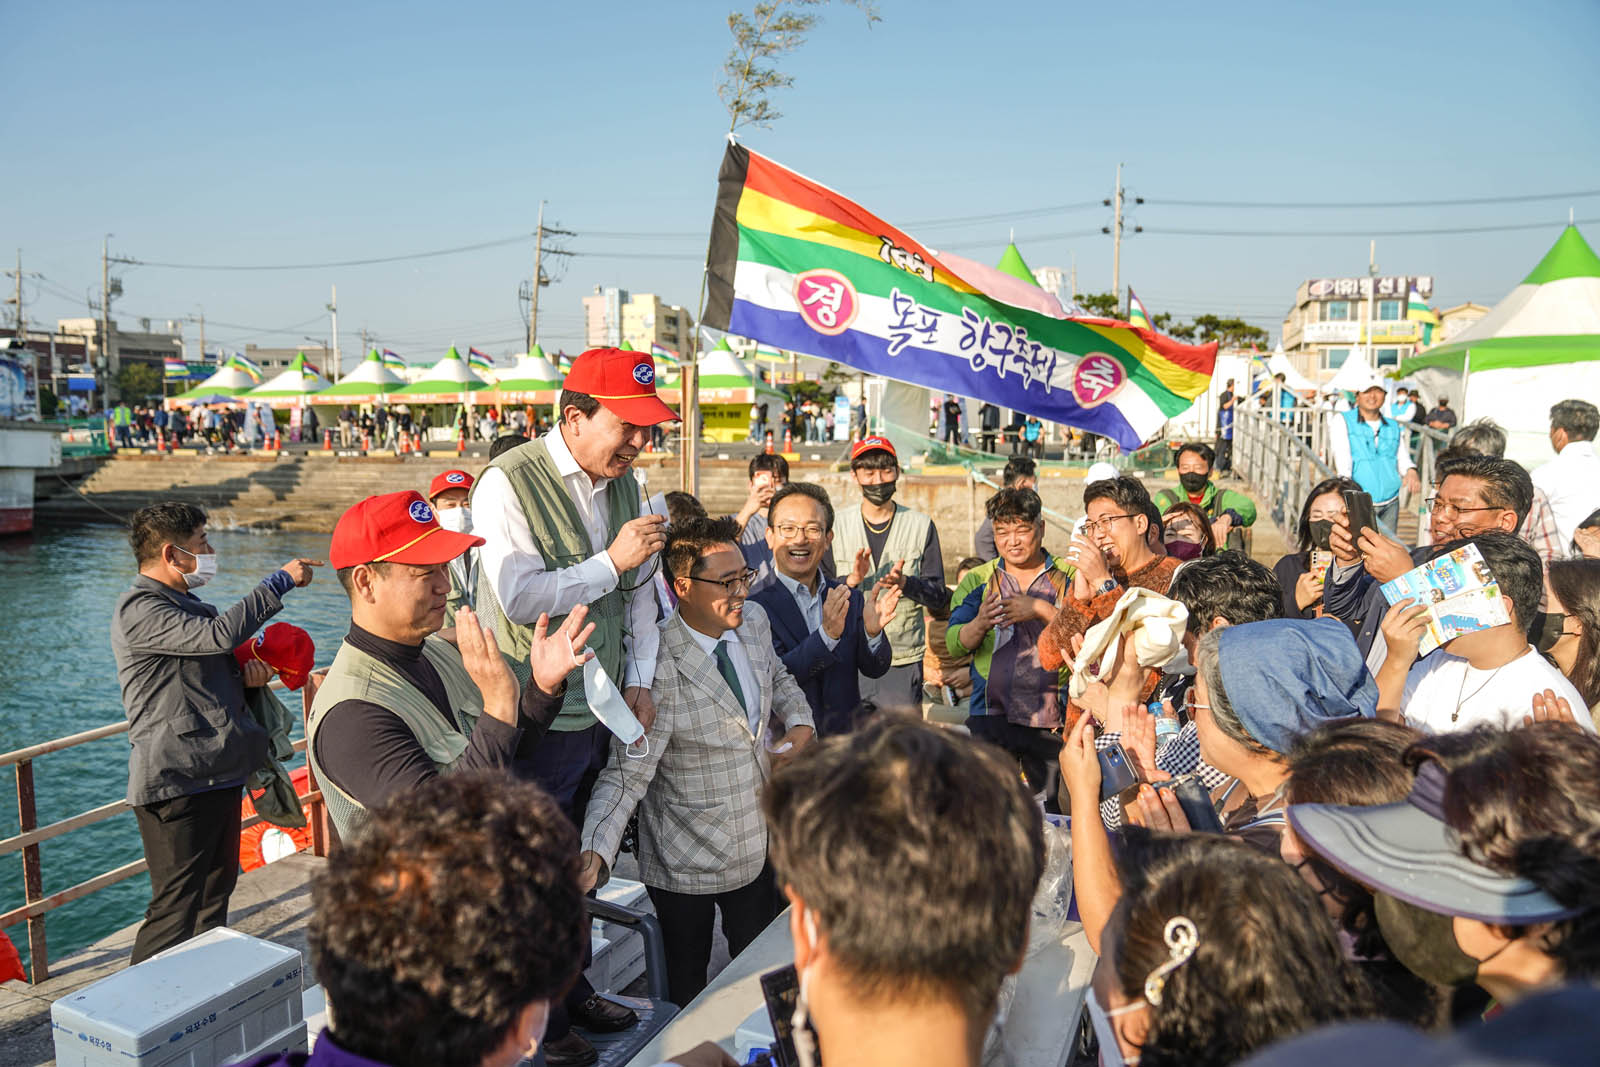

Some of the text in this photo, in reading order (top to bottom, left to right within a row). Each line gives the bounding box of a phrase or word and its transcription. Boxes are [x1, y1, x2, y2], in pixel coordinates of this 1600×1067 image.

[803, 279, 1116, 400] 경 목포 항구축제 축
[185, 1012, 217, 1034] 목포수협
[89, 1035, 112, 1052] 목포수협
